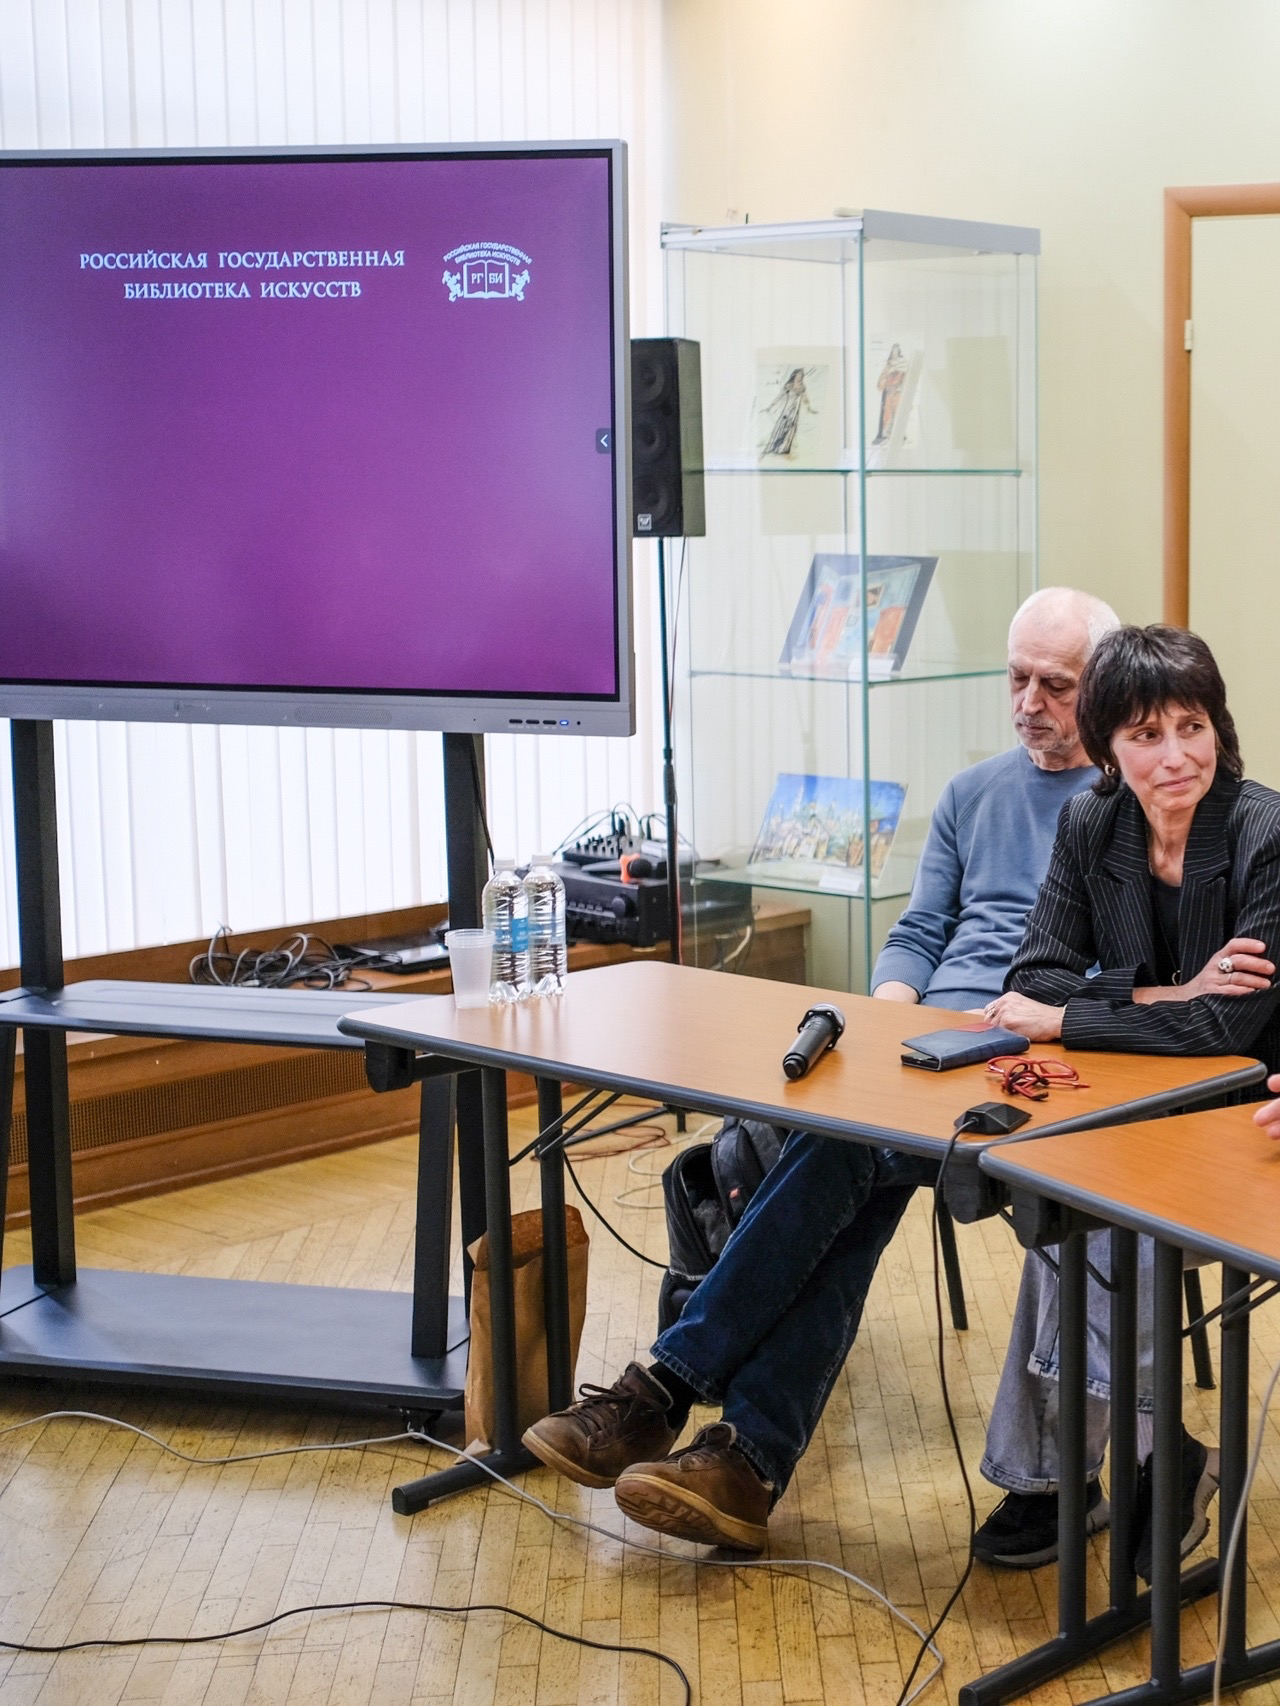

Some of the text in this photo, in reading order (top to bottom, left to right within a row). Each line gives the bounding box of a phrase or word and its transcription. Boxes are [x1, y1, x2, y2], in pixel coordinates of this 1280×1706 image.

[79, 249, 405, 271] РОССИЙСКАЯ ГОСУДАРСТВЕННАЯ
[123, 281, 362, 299] БИБЛИОТЕКА ИСКУССТВ
